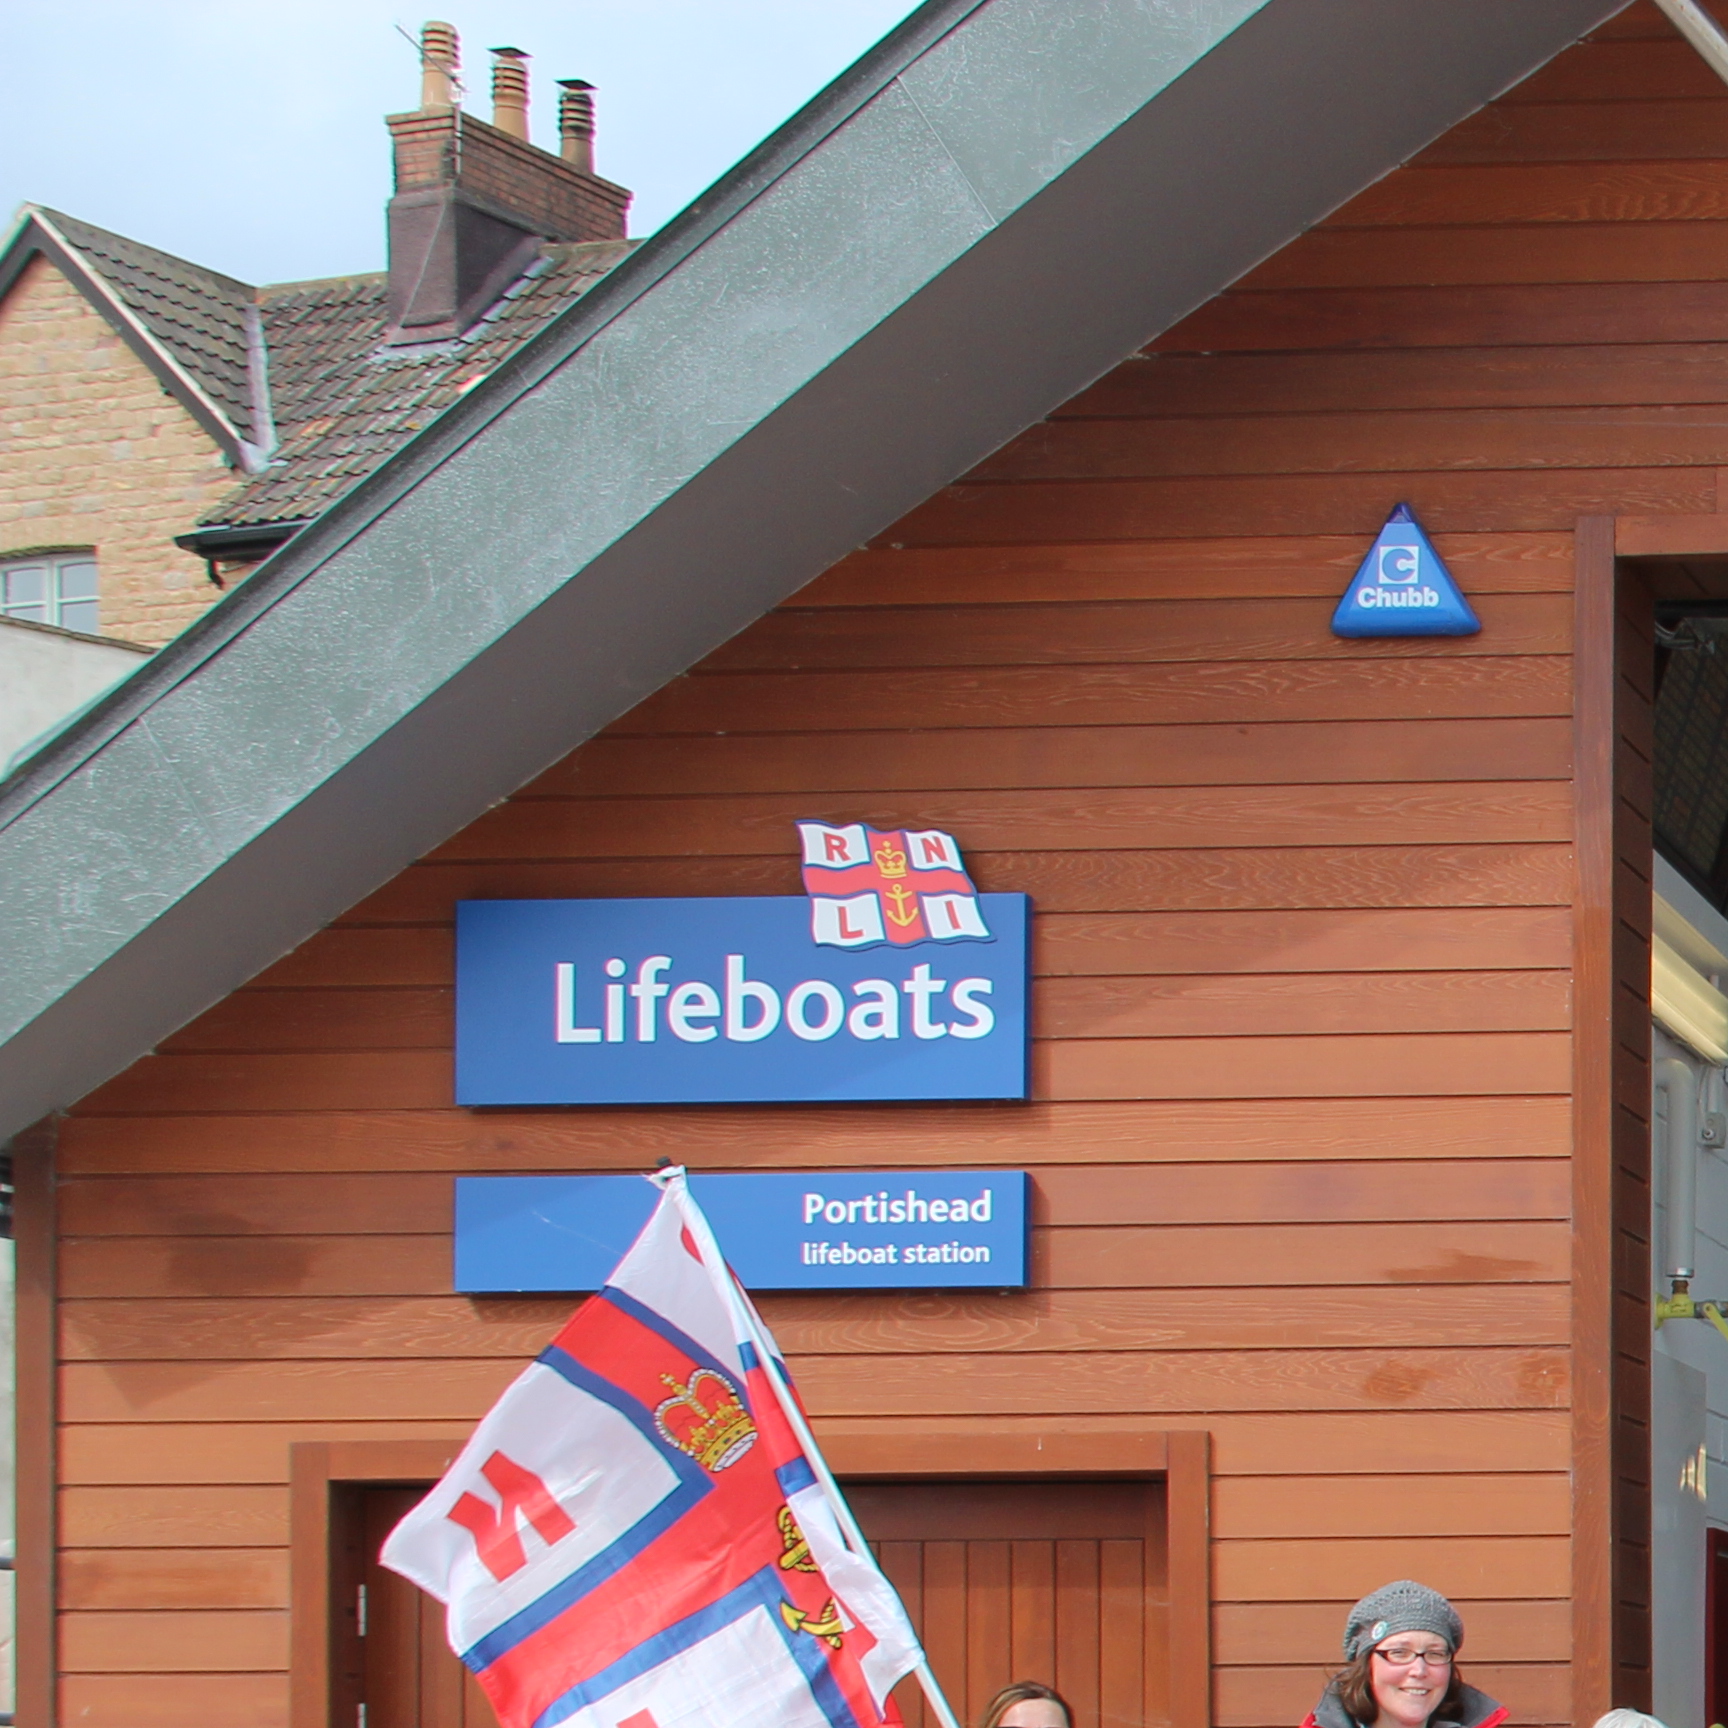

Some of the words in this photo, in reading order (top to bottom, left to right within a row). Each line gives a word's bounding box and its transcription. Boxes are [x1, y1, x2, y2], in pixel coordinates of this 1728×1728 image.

[1357, 587, 1440, 609] Chubb
[823, 832, 851, 862] R
[921, 836, 948, 863] N
[837, 906, 864, 939] L
[945, 901, 962, 930] I
[555, 954, 997, 1045] Lifeboats
[803, 1190, 994, 1226] Portishead
[802, 1239, 899, 1267] lifeboat
[904, 1239, 991, 1267] station
